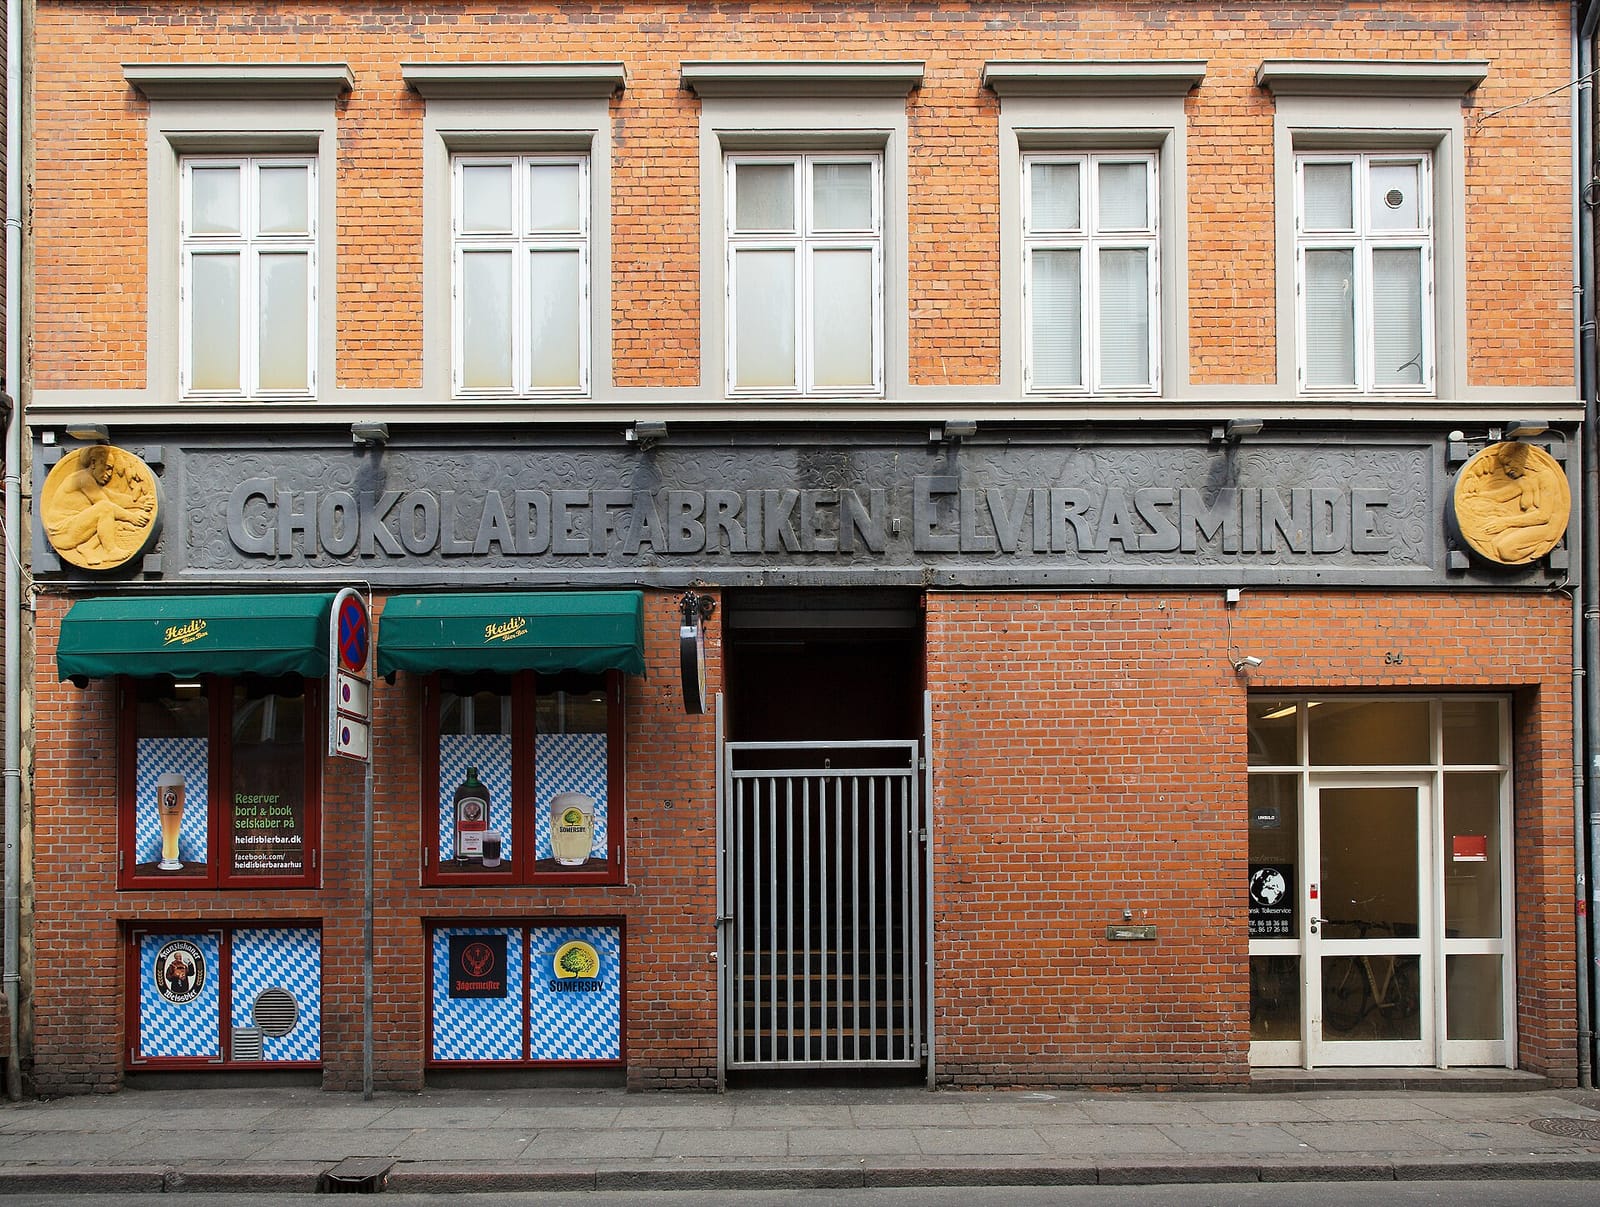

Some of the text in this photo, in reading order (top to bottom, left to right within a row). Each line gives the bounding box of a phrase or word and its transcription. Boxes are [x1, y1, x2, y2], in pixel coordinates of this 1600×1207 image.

[226, 475, 1390, 557] CHOKOLADEFABRIKEN ELVIRASMINDE
[164, 619, 206, 641] Heidi's
[484, 616, 526, 638] Heidi's
[1384, 651, 1403, 666] 34
[235, 793, 280, 804] Reserver
[235, 805, 293, 816] bord & book
[235, 817, 295, 829] selskaber på
[234, 835, 302, 844] heidisbierbar.dk
[234, 853, 286, 861] facebook.com/
[234, 861, 302, 869] heidisbierbaraarhus
[455, 980, 500, 991] Jägermeister
[549, 979, 604, 993] SOMERSBY
[163, 988, 197, 1002] Weissbier
